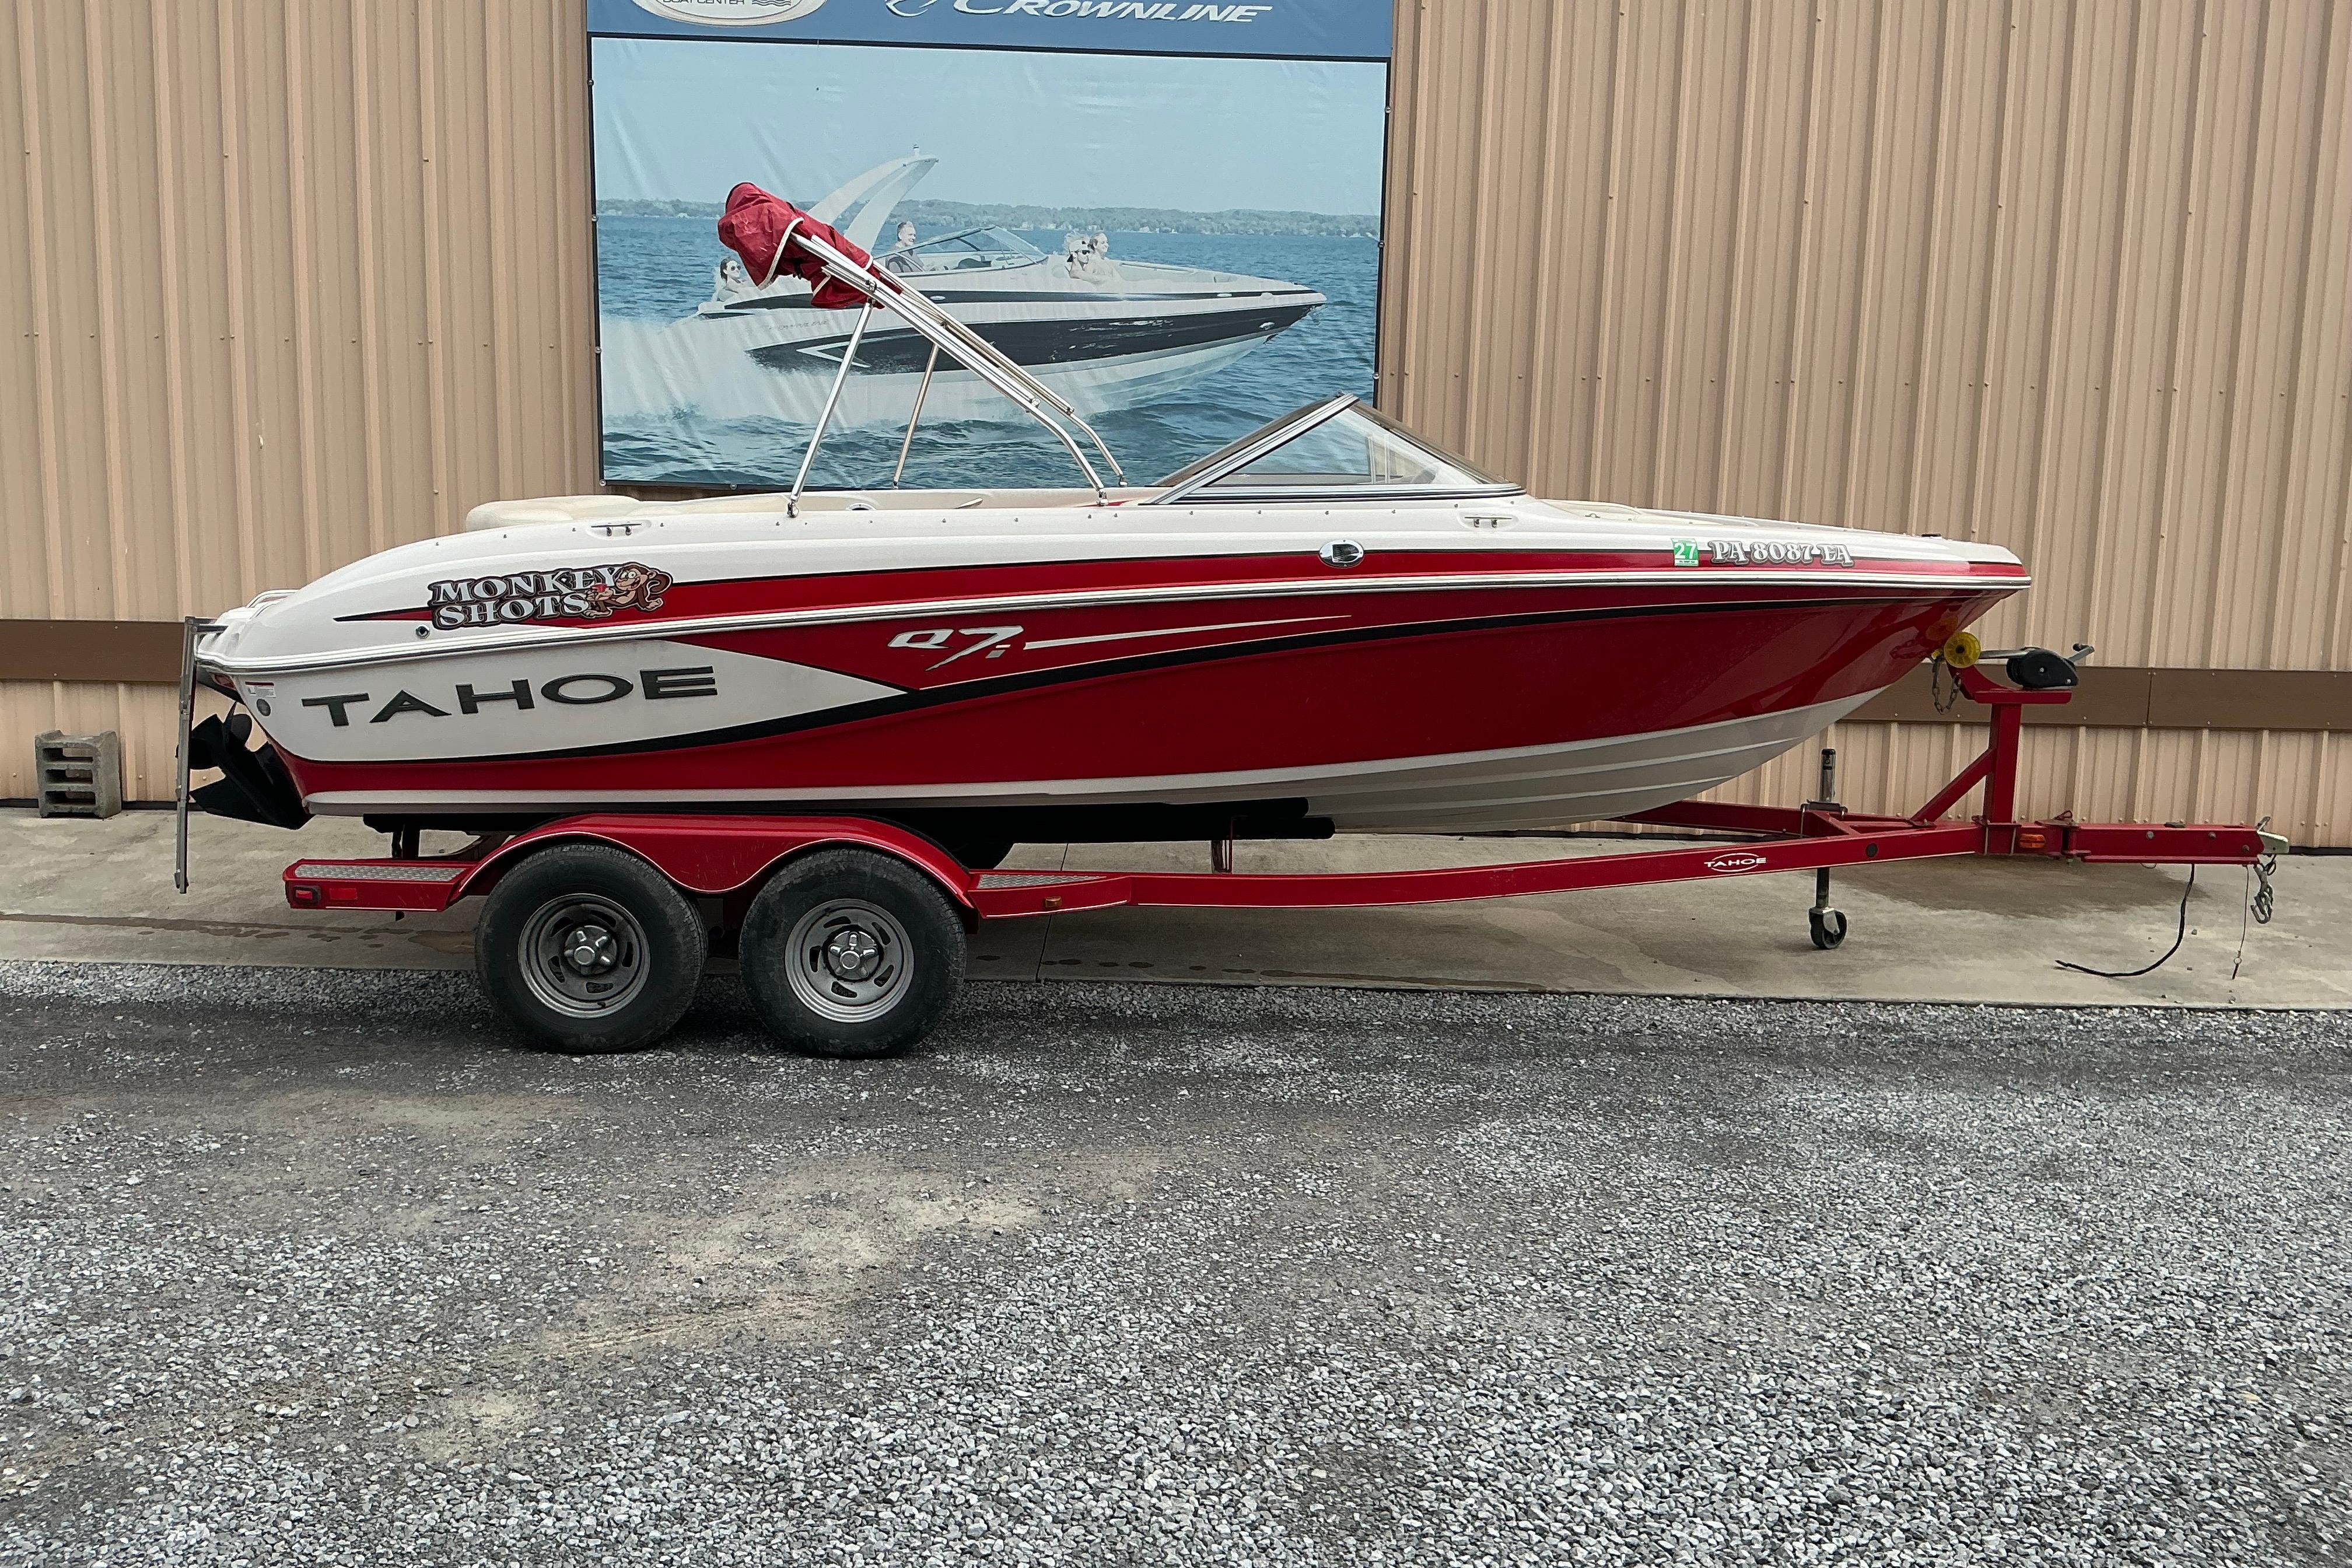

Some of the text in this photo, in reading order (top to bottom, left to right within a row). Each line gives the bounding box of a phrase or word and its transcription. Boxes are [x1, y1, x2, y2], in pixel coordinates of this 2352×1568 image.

[1674, 542, 1697, 559] 27
[1709, 541, 1854, 566] PA 8087 EA
[435, 566, 624, 604] MONKEY
[438, 593, 589, 626] SHOTS
[301, 665, 718, 727] TAHOE
[1703, 857, 1766, 868] TAHOE
